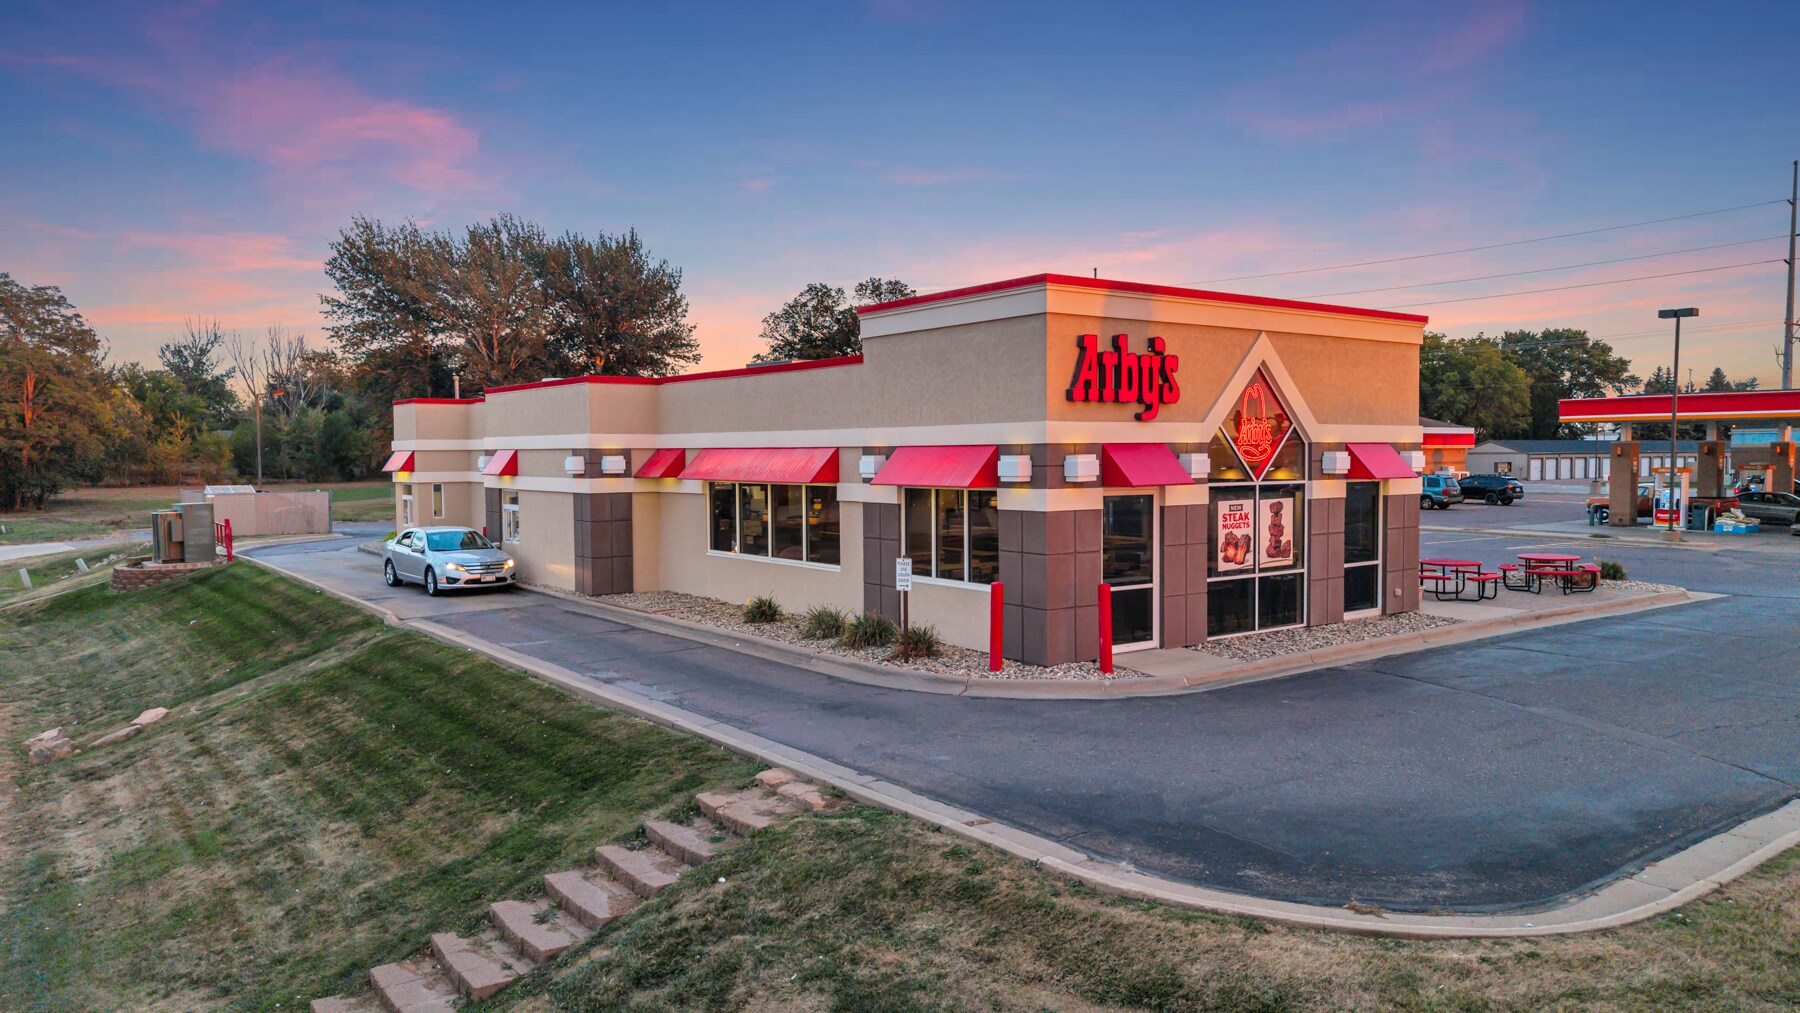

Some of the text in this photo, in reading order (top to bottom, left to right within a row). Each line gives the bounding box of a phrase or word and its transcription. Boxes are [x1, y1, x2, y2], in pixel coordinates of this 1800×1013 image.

[1067, 333, 1180, 421] Arby's
[1238, 417, 1272, 451] Arby's
[1222, 512, 1250, 522] STEAK
[1222, 522, 1250, 530] NUGGETS
